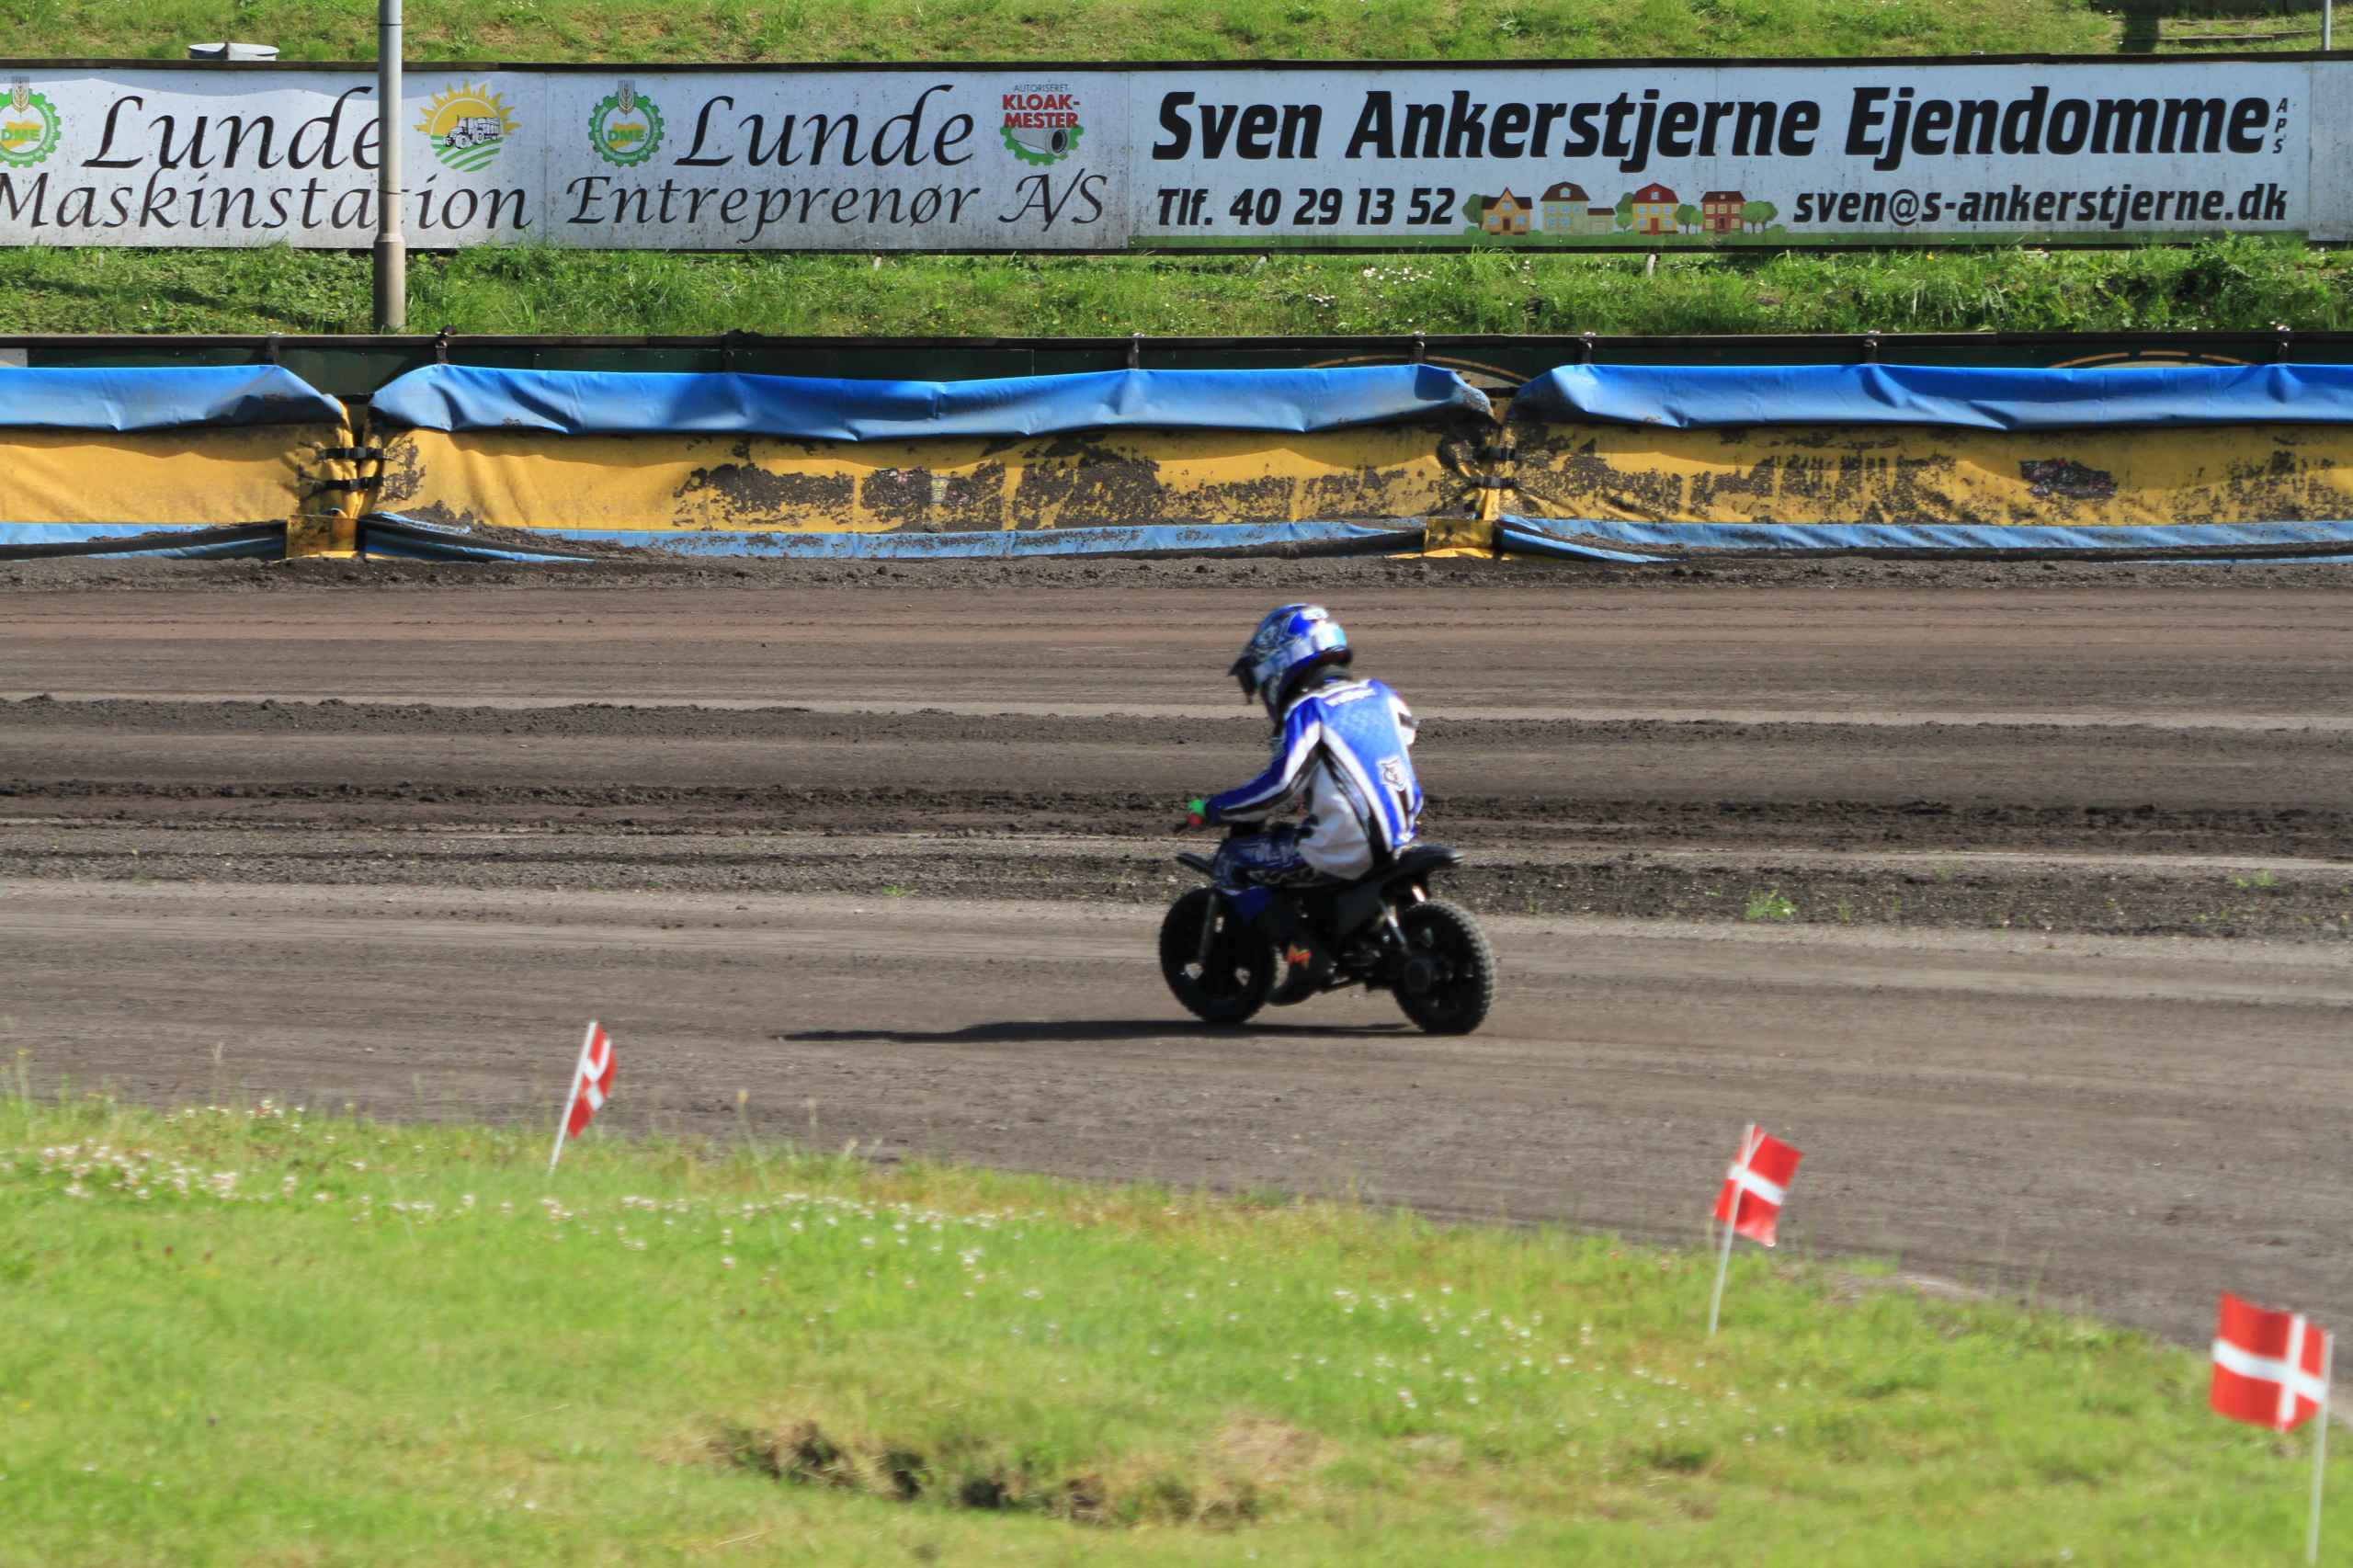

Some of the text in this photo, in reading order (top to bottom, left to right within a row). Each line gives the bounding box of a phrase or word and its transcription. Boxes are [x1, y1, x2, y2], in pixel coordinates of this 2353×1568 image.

[81, 85, 381, 172] Lunde
[673, 84, 974, 167] Lunde
[1003, 94, 1081, 110] KLOAK-
[1004, 112, 1079, 129] MESTER
[1152, 85, 2270, 174] Sven Ankerstjerne Ejendomme
[0, 165, 533, 230] Maskinstaion
[565, 176, 981, 244] Entreprenør
[997, 167, 1108, 233] A/S
[1157, 187, 1456, 226] Tlf. 40 29 13 52
[1793, 182, 2288, 231] sven@s-ankerstjerne.dk
